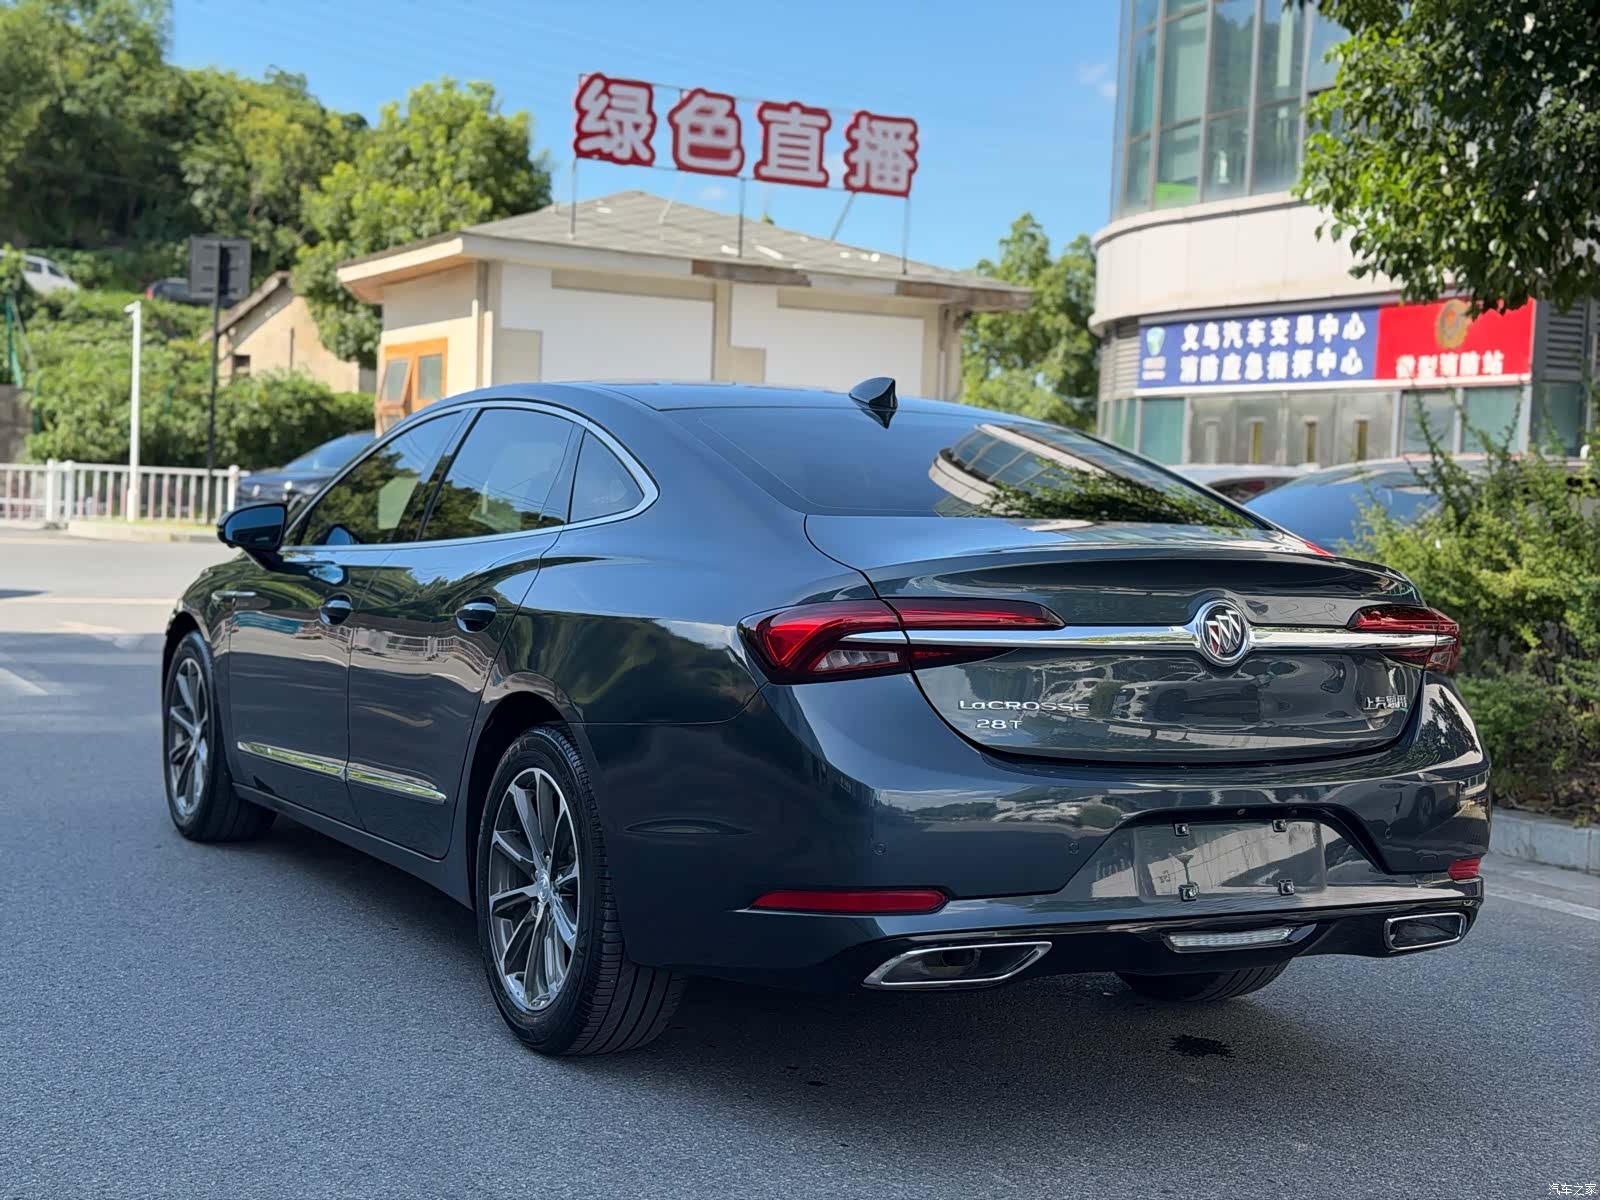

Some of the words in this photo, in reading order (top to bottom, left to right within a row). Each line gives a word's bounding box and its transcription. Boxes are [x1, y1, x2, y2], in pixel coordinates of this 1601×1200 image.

[575, 74, 918, 196] 绿色直播
[1181, 312, 1366, 351] 义乌汽车交易中心
[959, 700, 1090, 711] LaCROSSE
[976, 719, 1023, 730] 28T
